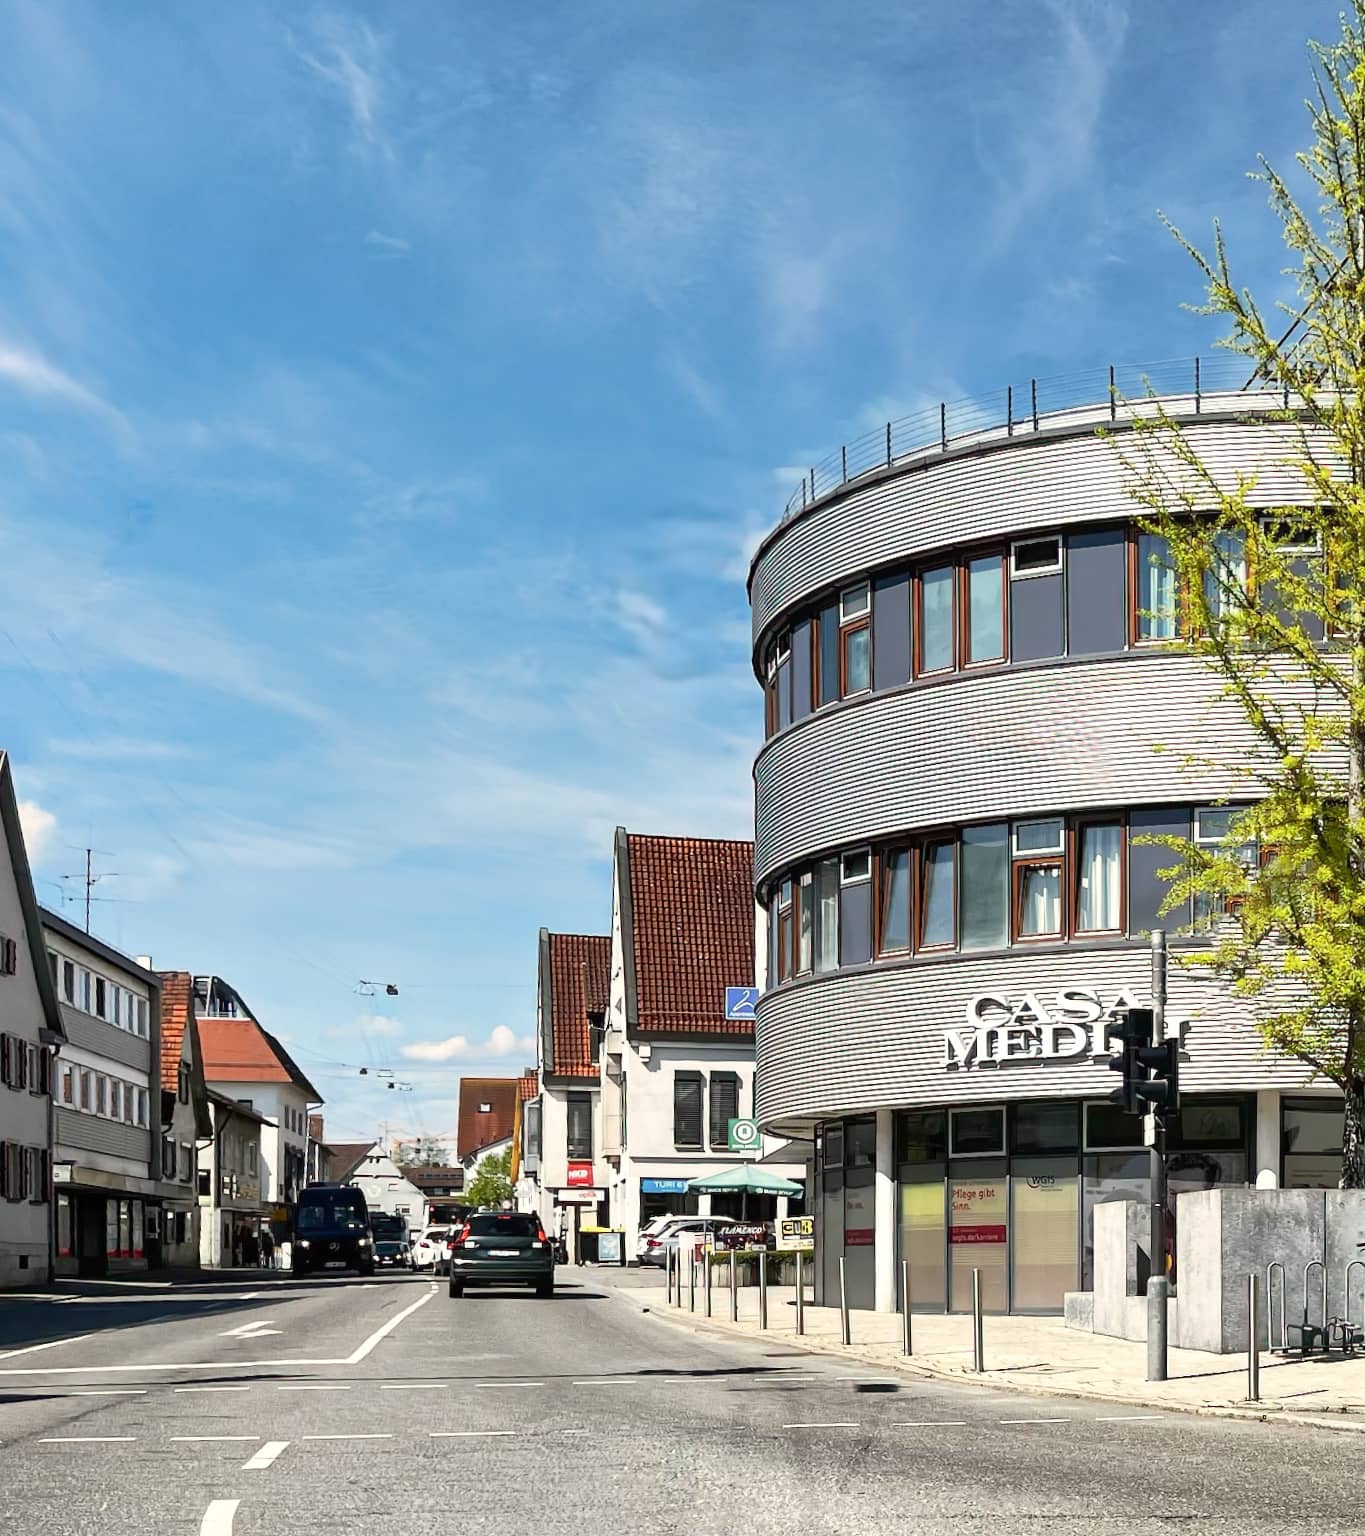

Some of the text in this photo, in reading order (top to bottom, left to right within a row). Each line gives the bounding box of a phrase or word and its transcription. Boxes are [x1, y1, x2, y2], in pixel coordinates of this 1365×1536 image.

[966, 987, 1143, 1028] CASA
[941, 1019, 1190, 1066] MEDII
[952, 1187, 996, 1200] Pflege gibt
